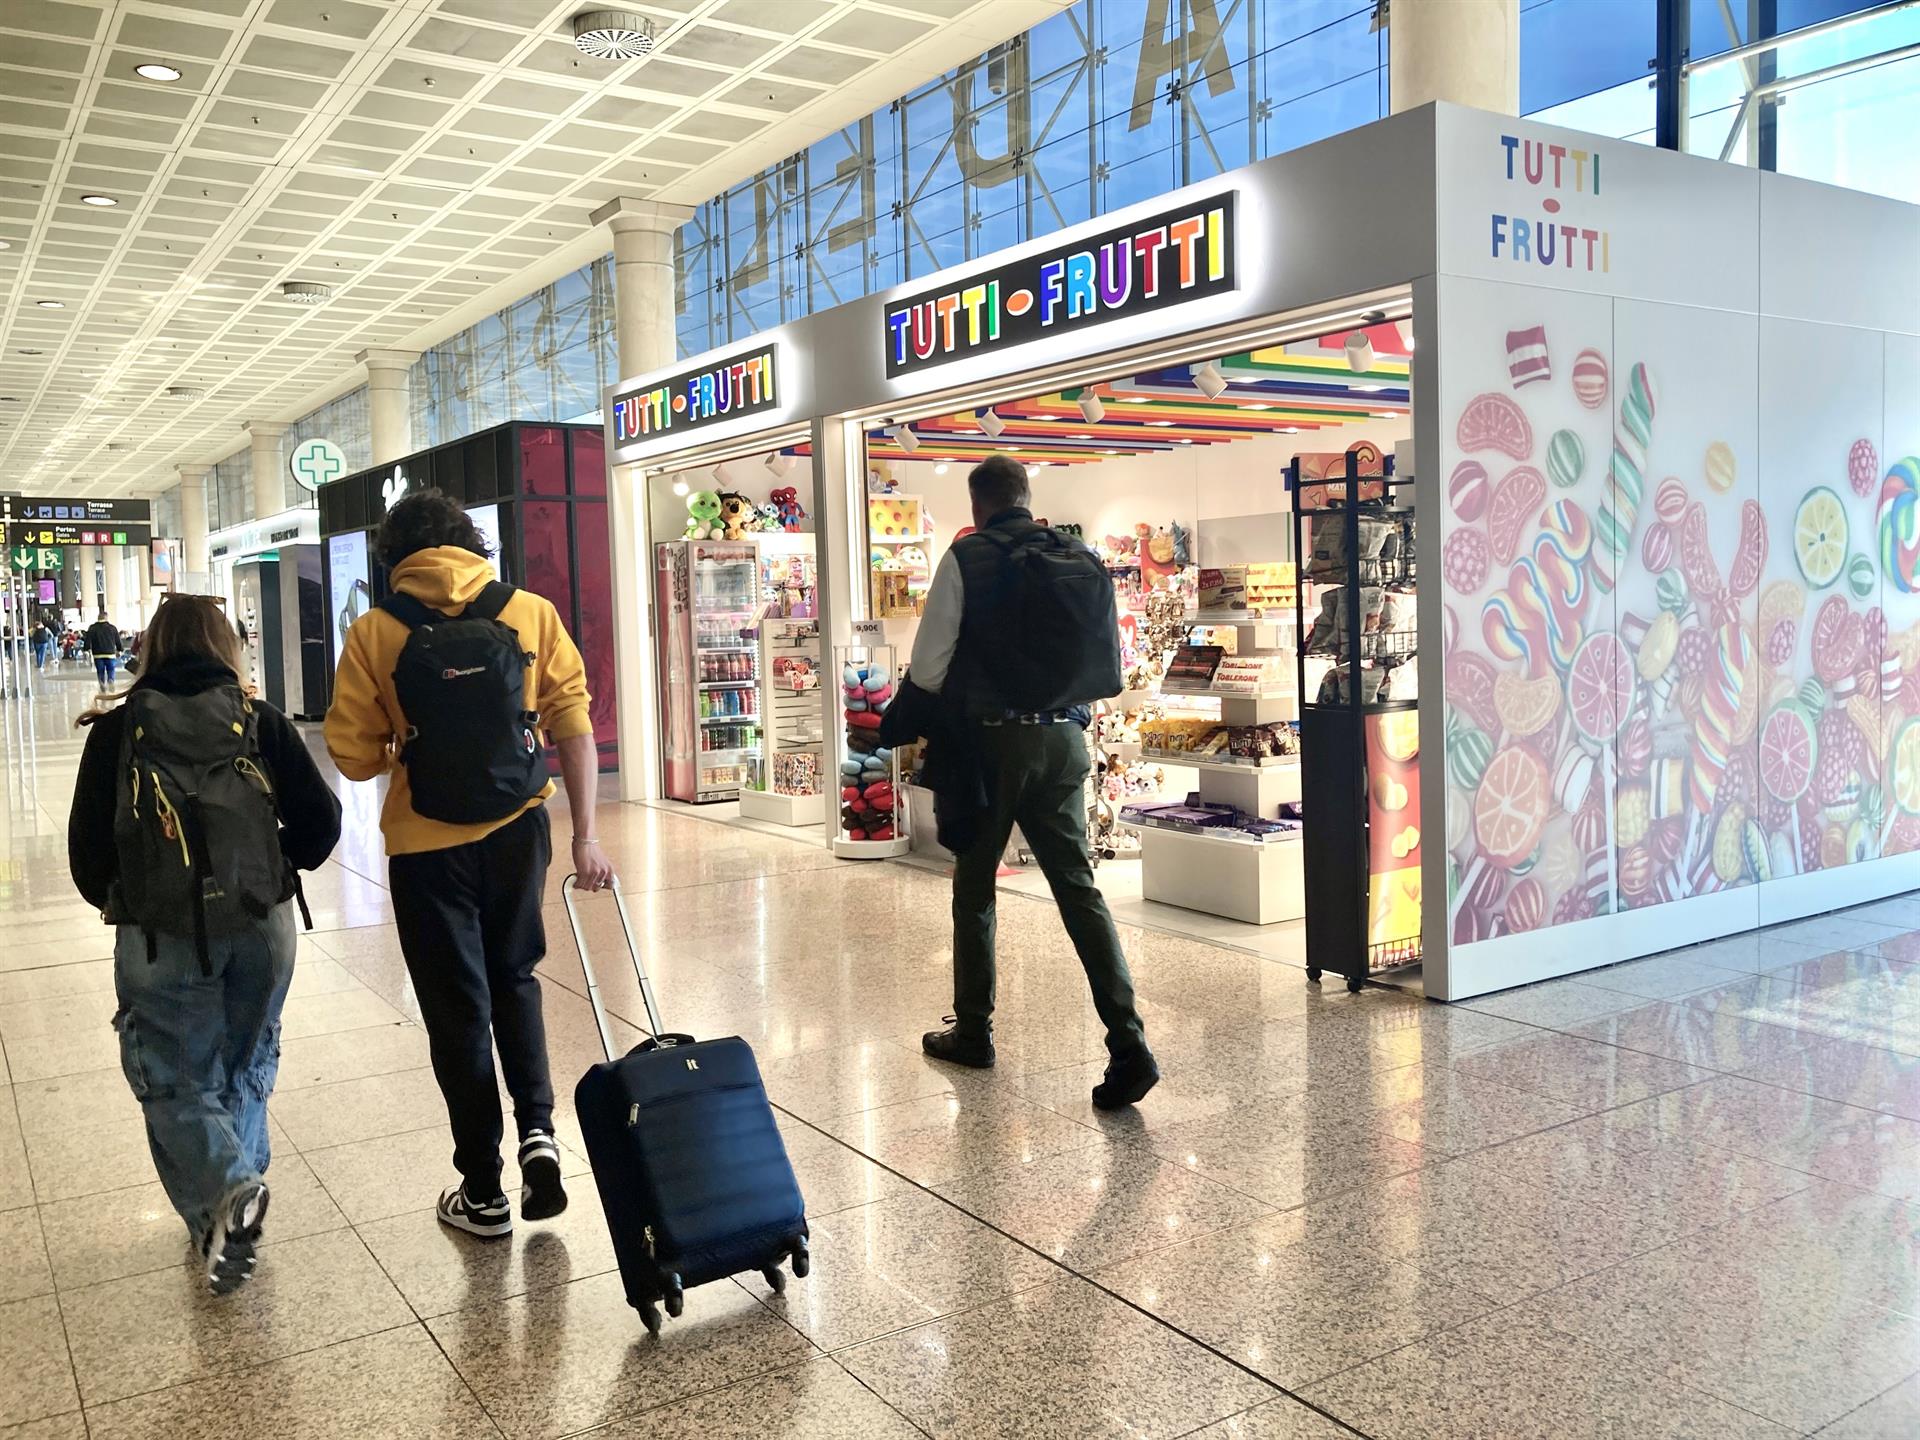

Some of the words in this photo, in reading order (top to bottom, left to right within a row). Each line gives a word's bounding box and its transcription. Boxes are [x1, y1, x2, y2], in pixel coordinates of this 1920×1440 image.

[1501, 135, 1600, 195] TUTTI
[1491, 214, 1609, 273] FRUTTI
[889, 280, 999, 366] TUTTI
[1040, 207, 1225, 327] FRUTTI
[615, 386, 672, 441] TUTTI
[688, 353, 773, 421] FRUTTI
[856, 624, 878, 632] 9,90€
